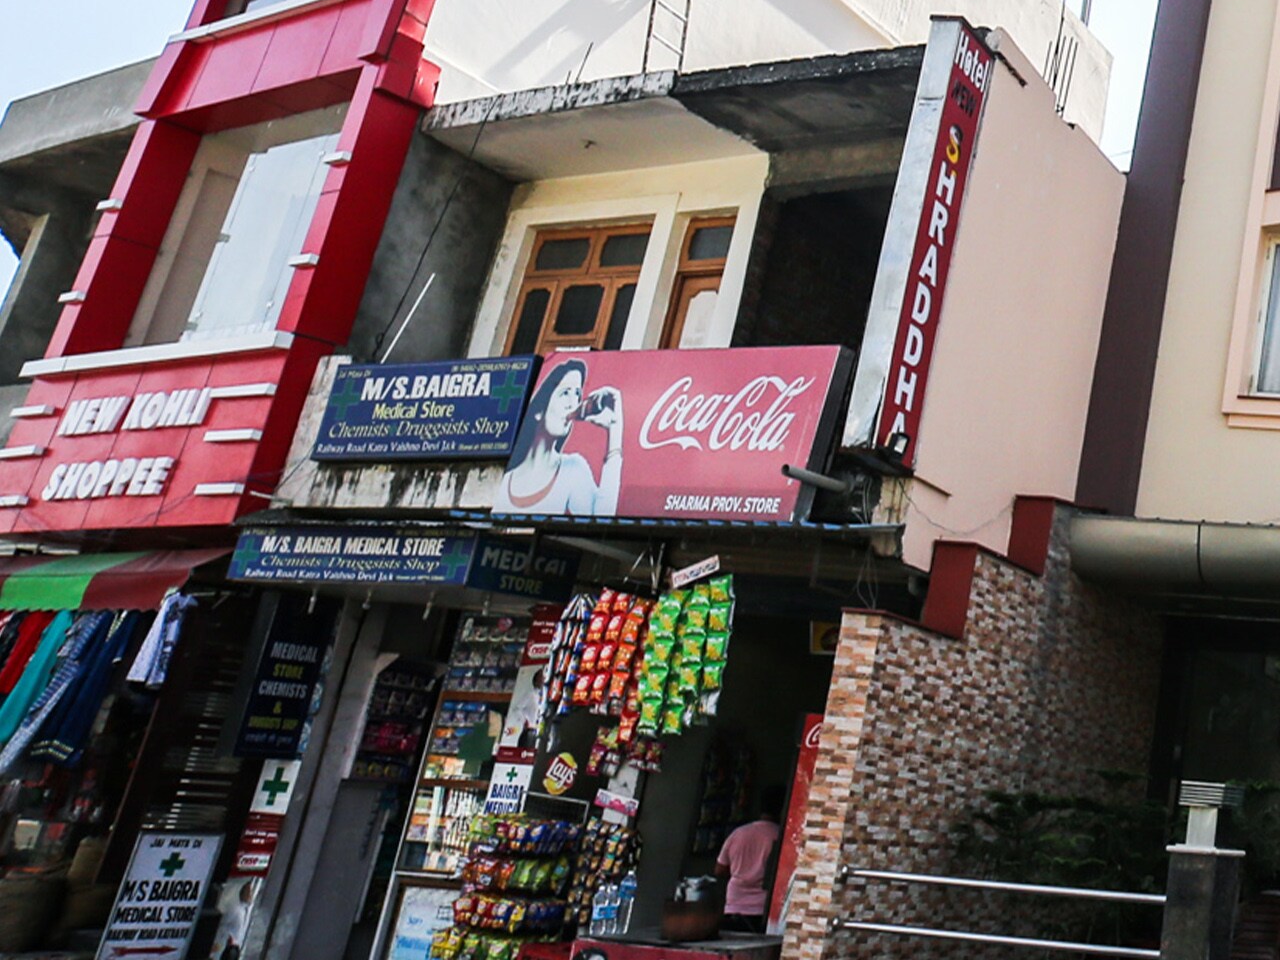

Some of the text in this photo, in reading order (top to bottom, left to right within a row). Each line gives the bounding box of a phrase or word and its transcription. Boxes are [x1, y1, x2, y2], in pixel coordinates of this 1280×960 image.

[955, 31, 990, 93] Hotel
[57, 387, 213, 436] NEW KOHLI
[372, 401, 455, 420] Medical Store
[328, 417, 510, 440] Chemists Druggsists Shop
[316, 442, 345, 455] Railway
[346, 442, 366, 453] Road
[367, 442, 388, 453] Katra
[421, 440, 440, 451] Devi
[41, 456, 176, 501] SHOPPEE
[664, 495, 781, 514] SHARMA PROV. STORE
[260, 535, 446, 557] M/S. BAIGRA MEDICAL STORE
[260, 554, 321, 568] Chemists
[403, 558, 441, 573] Shop
[499, 573, 544, 595] STORE
[270, 641, 319, 662] MEDICAL
[273, 663, 304, 679] STORE
[258, 680, 308, 699] CHEMISTS
[148, 880, 201, 902] BAIGRA
[113, 906, 198, 924] MEDICAL STORE
